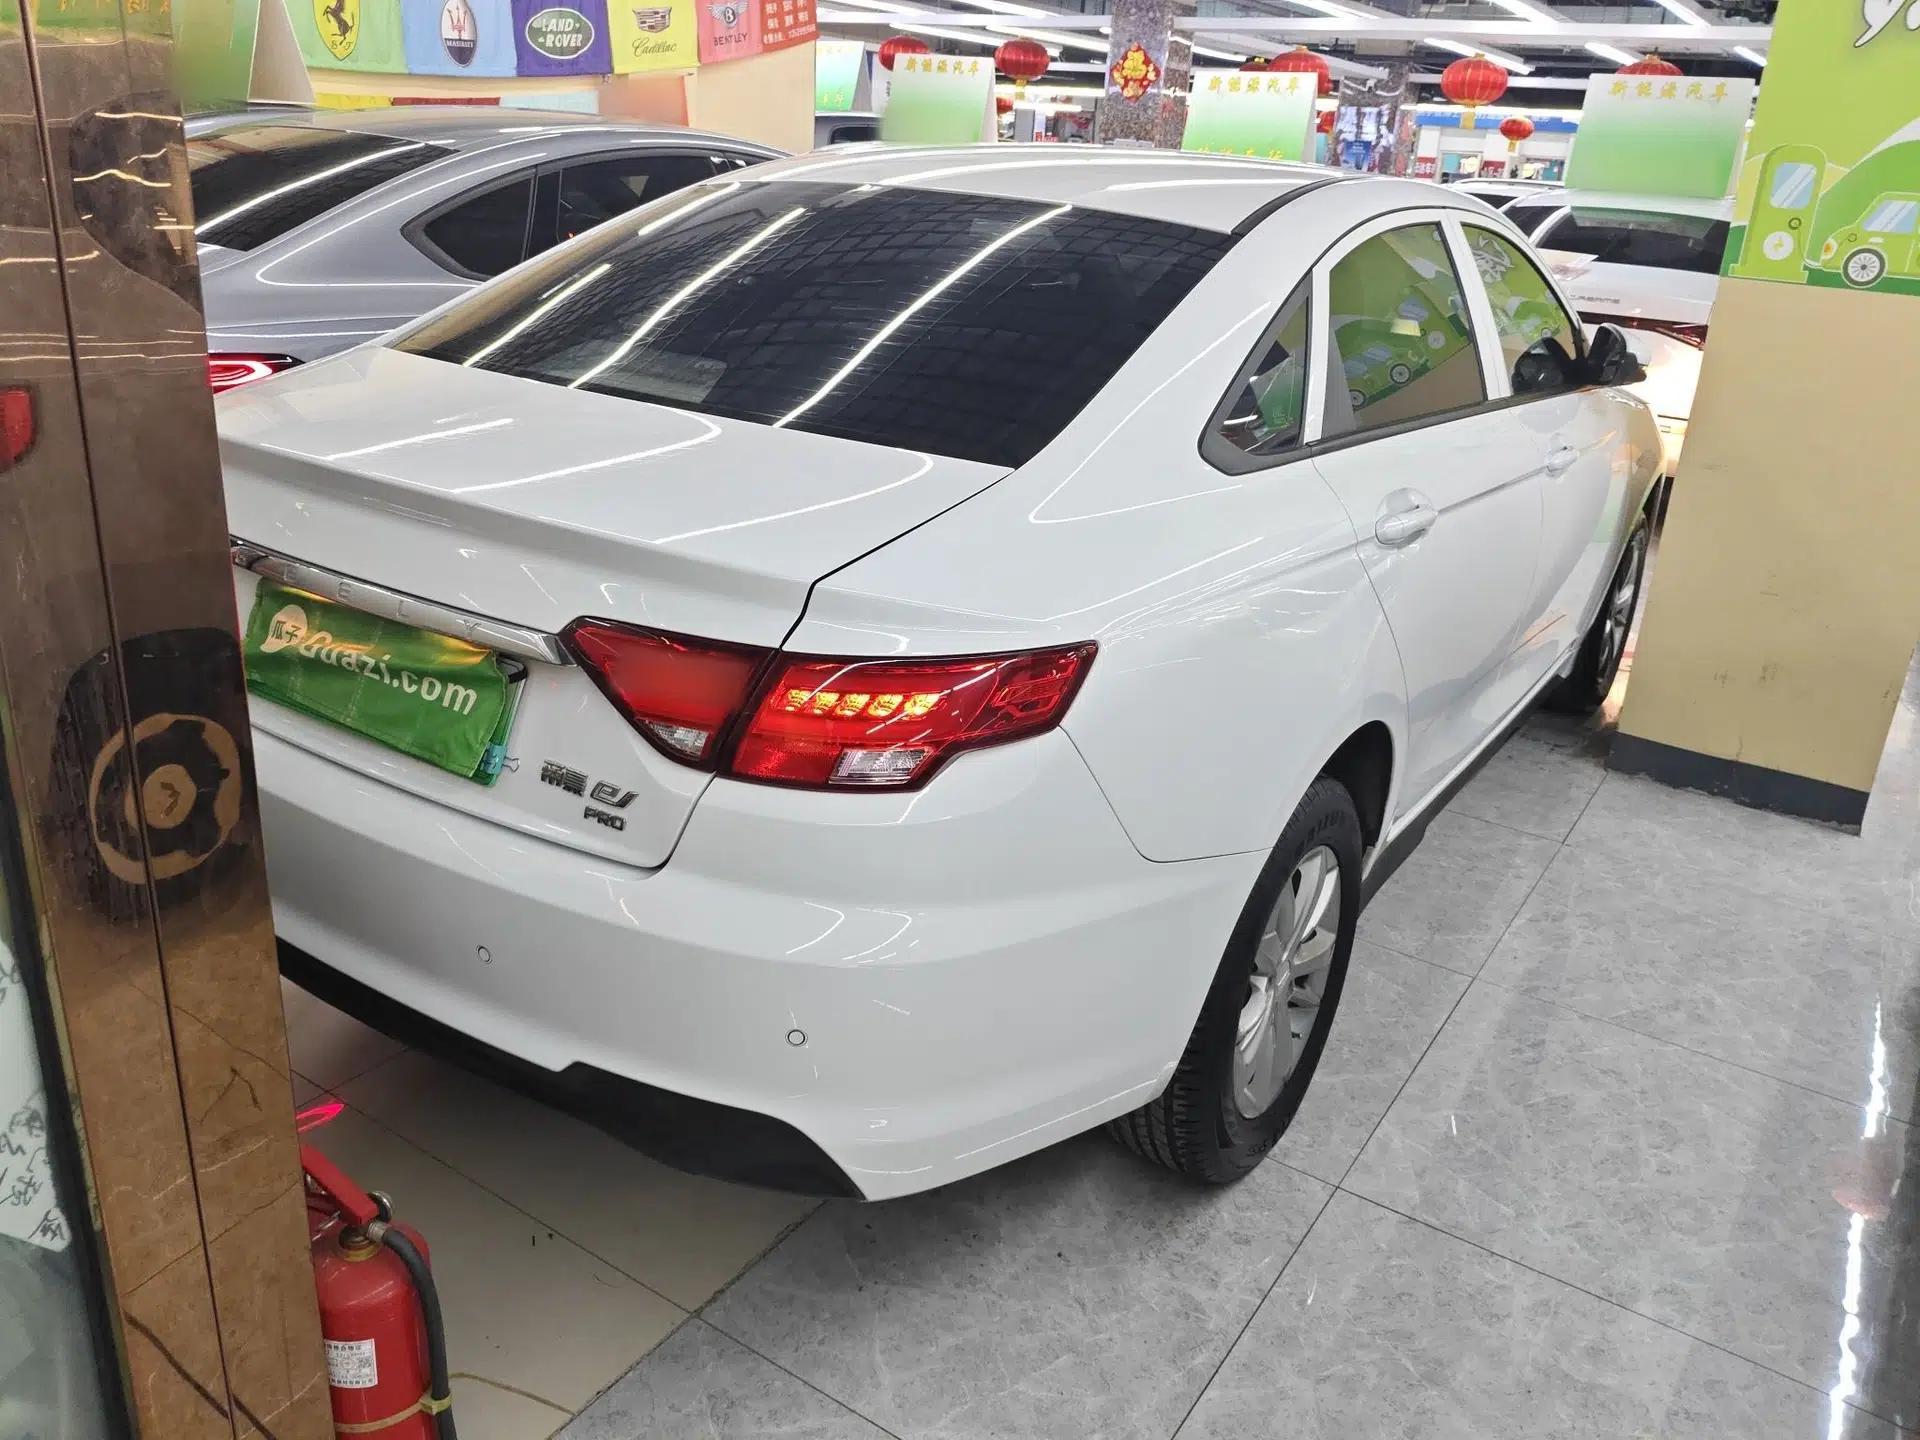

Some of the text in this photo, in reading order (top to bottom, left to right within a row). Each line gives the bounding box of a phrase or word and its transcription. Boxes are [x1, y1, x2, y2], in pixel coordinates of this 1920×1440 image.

[542, 18, 575, 32] LAND
[545, 33, 583, 48] ROVER
[631, 37, 677, 57] Cadillac
[713, 33, 748, 46] BENTLEY
[271, 620, 301, 644] 瓜子
[584, 806, 626, 831] PRO
